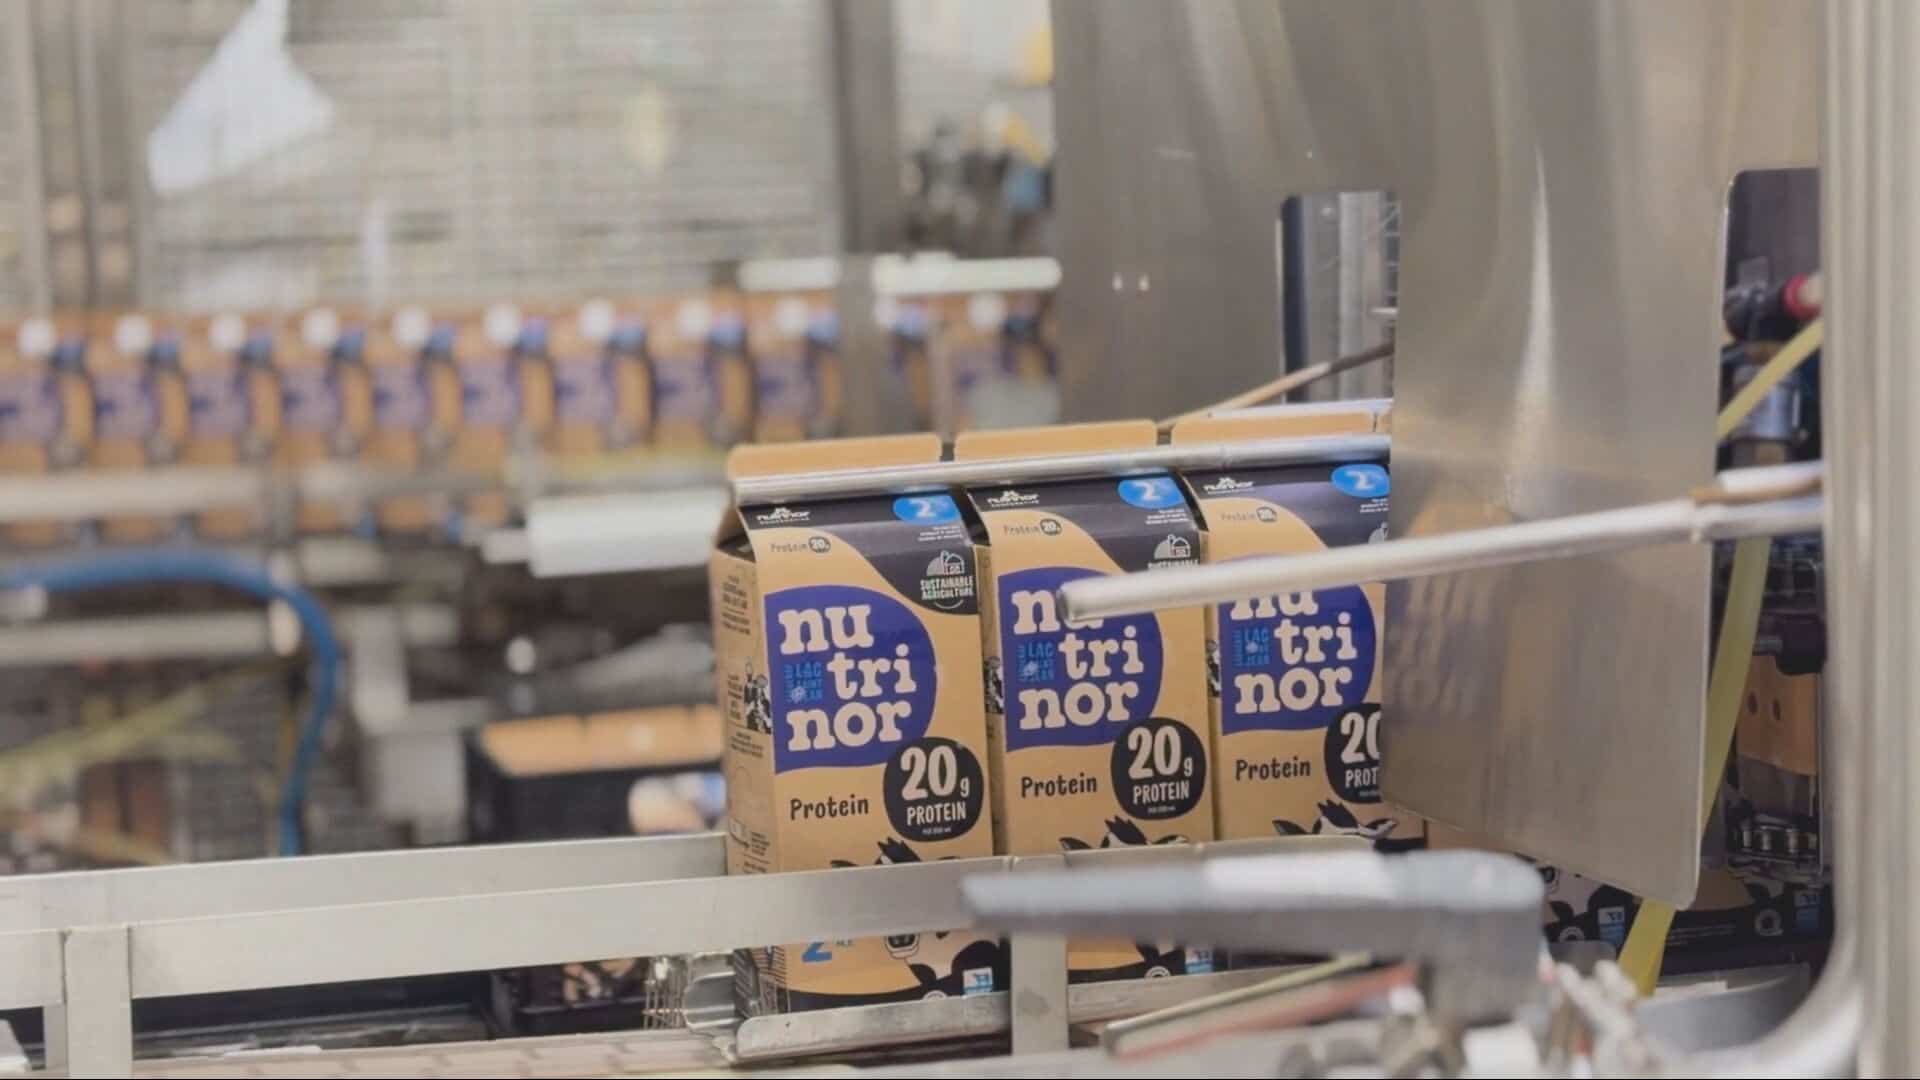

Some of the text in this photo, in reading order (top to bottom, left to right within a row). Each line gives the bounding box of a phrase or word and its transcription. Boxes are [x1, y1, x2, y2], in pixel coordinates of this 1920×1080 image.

[920, 575, 974, 592] SUSTAINABLE
[778, 604, 874, 655] nu
[1011, 590, 1104, 635] n
[1028, 641, 1053, 657] LAC
[1058, 625, 1144, 680] tri
[1273, 611, 1358, 665] tri
[827, 643, 917, 700] tri
[1234, 666, 1352, 714] nor
[786, 700, 912, 752] nor
[1018, 681, 1139, 730] nor
[1339, 712, 1382, 764] 20
[1021, 772, 1098, 799] Protein
[1235, 755, 1311, 781] Protein
[1345, 767, 1380, 788] PROT
[790, 794, 869, 820] Protein
[906, 801, 967, 827] PROTEIN
[1133, 780, 1190, 806] PROTEIN
